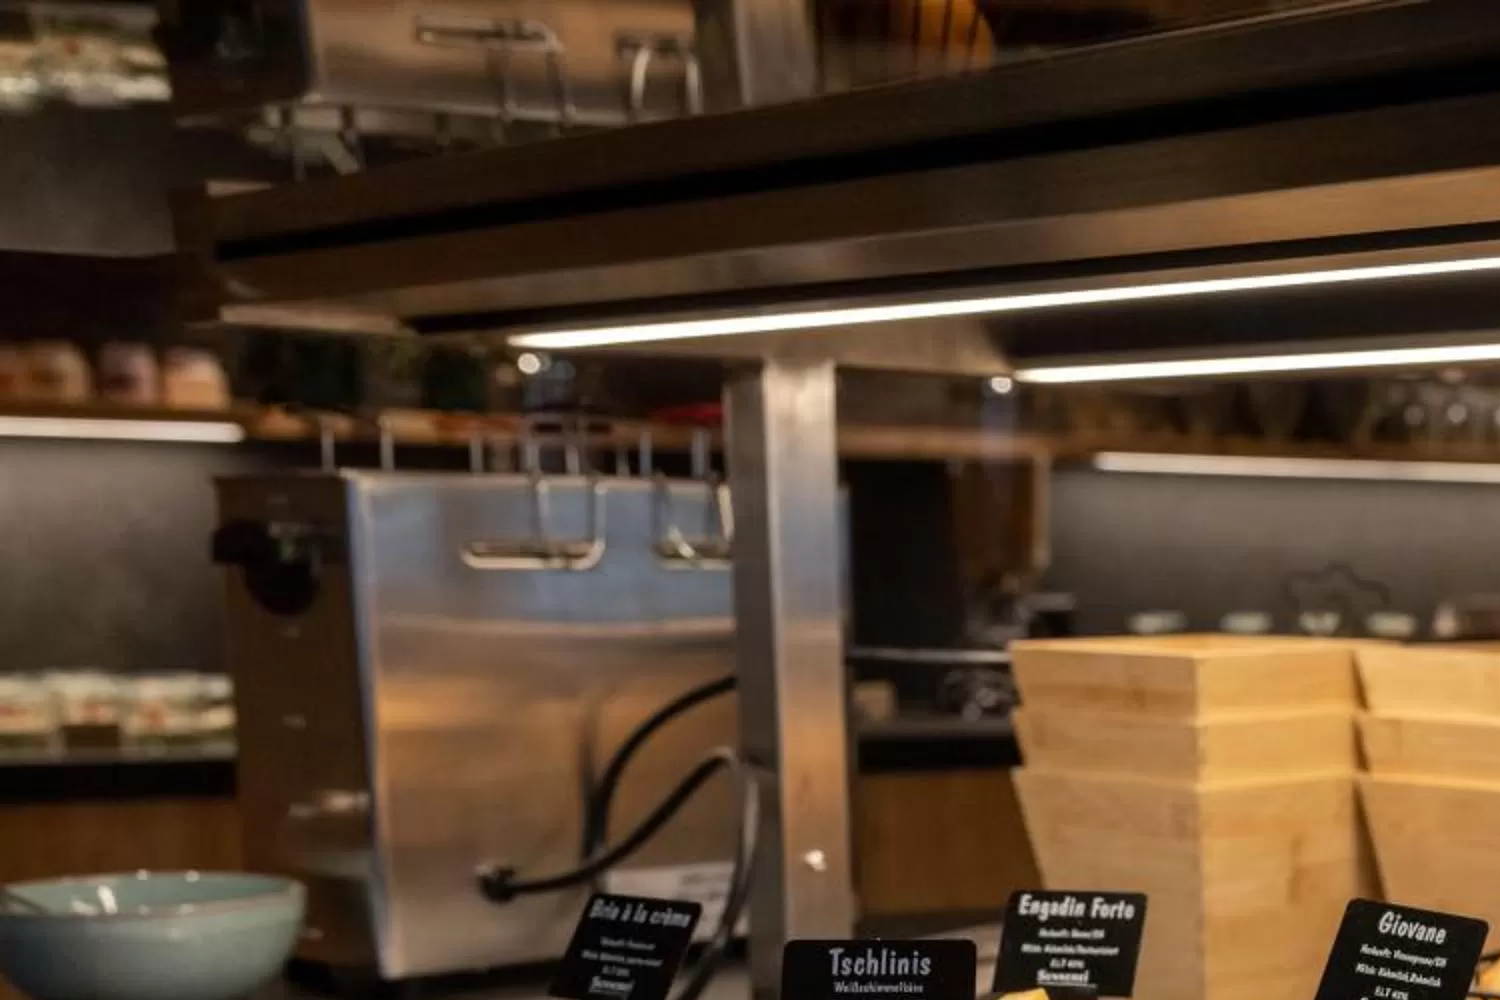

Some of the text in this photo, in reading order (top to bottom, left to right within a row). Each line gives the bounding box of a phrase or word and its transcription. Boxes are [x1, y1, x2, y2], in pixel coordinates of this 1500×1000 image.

[1018, 893, 1136, 922] Engadin Forte
[1378, 910, 1448, 945] Giovane
[828, 947, 932, 976] Tschlinis
